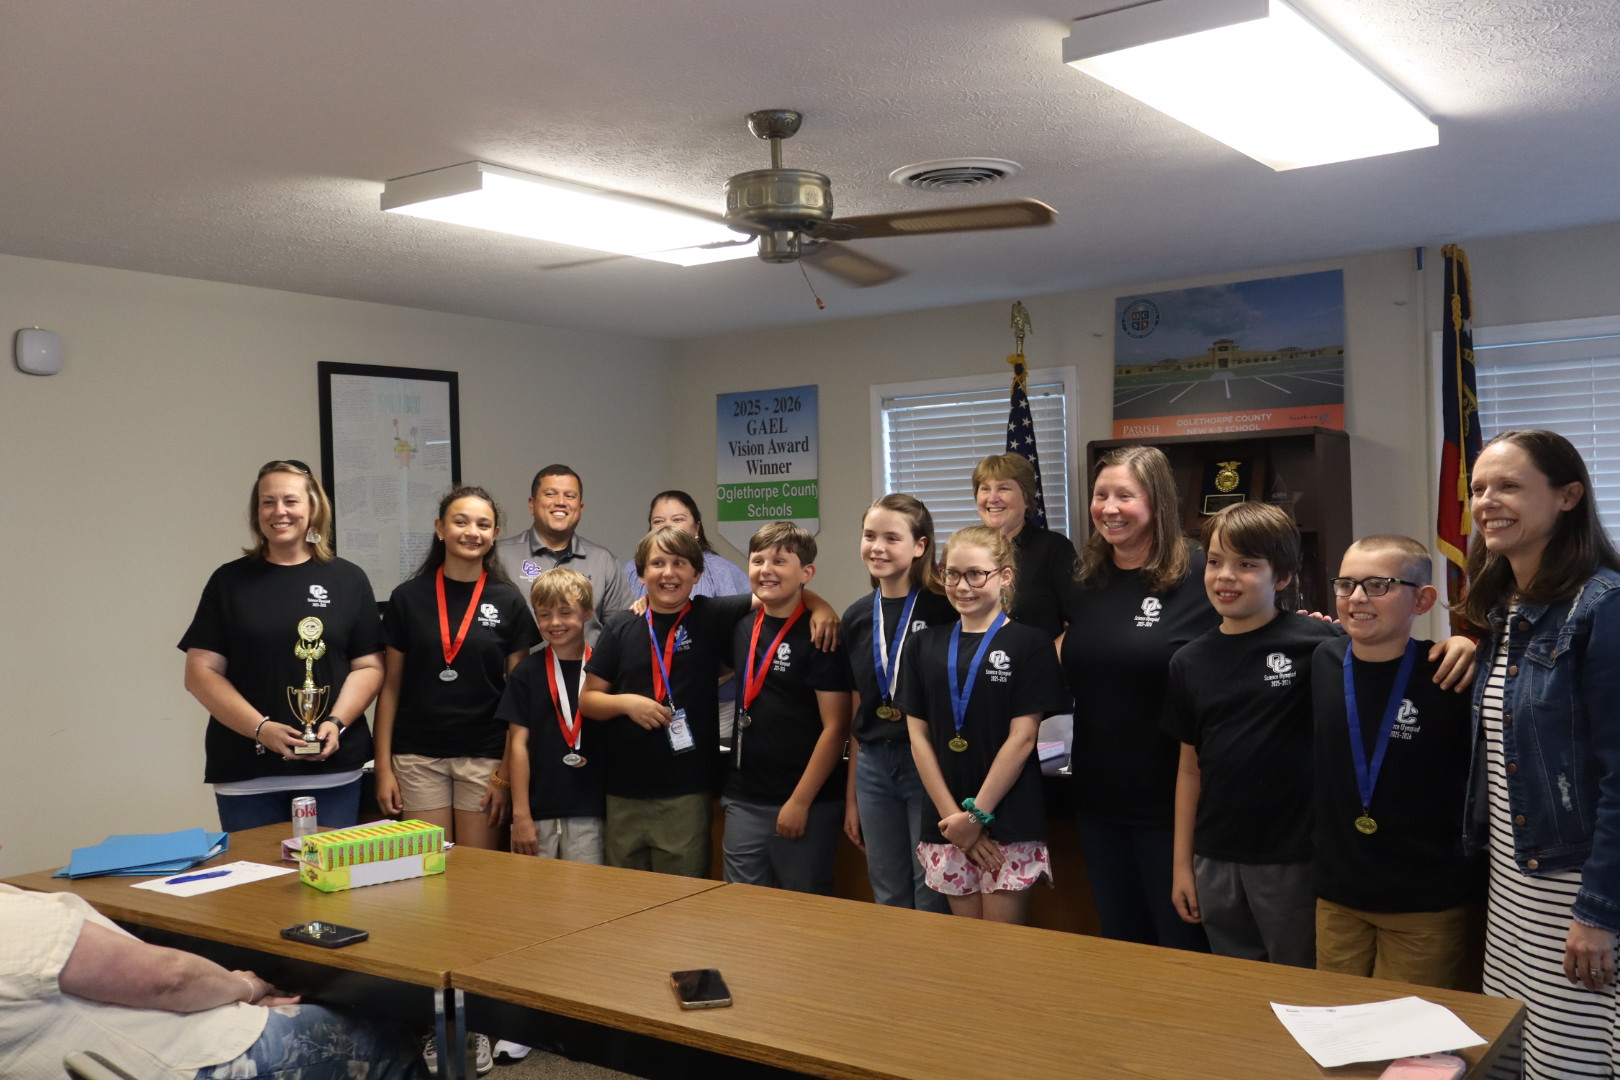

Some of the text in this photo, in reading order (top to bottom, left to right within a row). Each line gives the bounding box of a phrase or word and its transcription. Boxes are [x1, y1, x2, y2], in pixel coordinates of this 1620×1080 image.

[733, 399, 761, 417] 2025
[773, 395, 801, 414] 2026
[747, 417, 788, 436] GAEL
[1177, 413, 1273, 427] OGLETHORPE COUNTY
[1225, 424, 1261, 433] SCHOOL
[728, 436, 809, 457] Vision Award
[746, 459, 792, 476] Winner
[716, 483, 818, 503] Oglethorpe County
[747, 503, 793, 518] Schools
[1141, 596, 1162, 617] OC
[989, 650, 1010, 670] OC
[1266, 652, 1293, 673] OC
